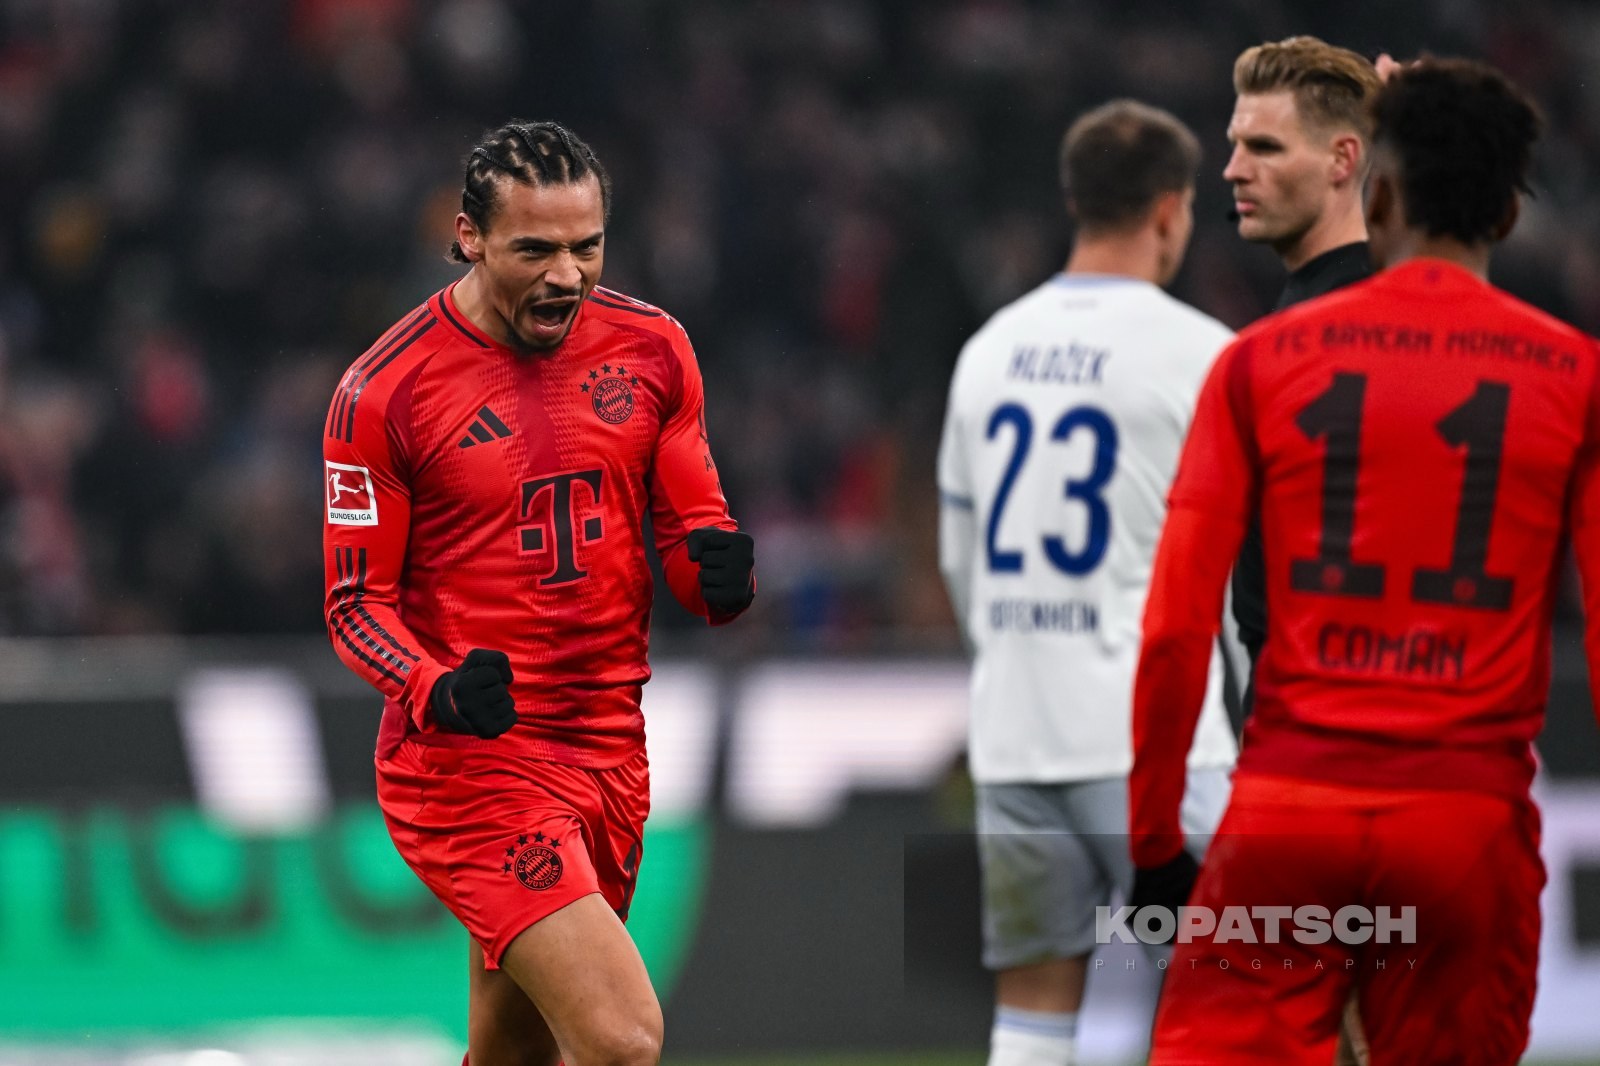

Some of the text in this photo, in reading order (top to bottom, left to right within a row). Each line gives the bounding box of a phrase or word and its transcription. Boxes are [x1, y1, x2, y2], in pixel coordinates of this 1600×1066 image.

[1320, 323, 1433, 353] BAYERN
[601, 380, 630, 396] BAYERN
[984, 402, 1120, 580] 23
[1290, 371, 1516, 612] 11
[330, 511, 372, 521] BUNDESLIGA
[1316, 622, 1468, 679] COMAN
[521, 848, 554, 862] BAYERN
